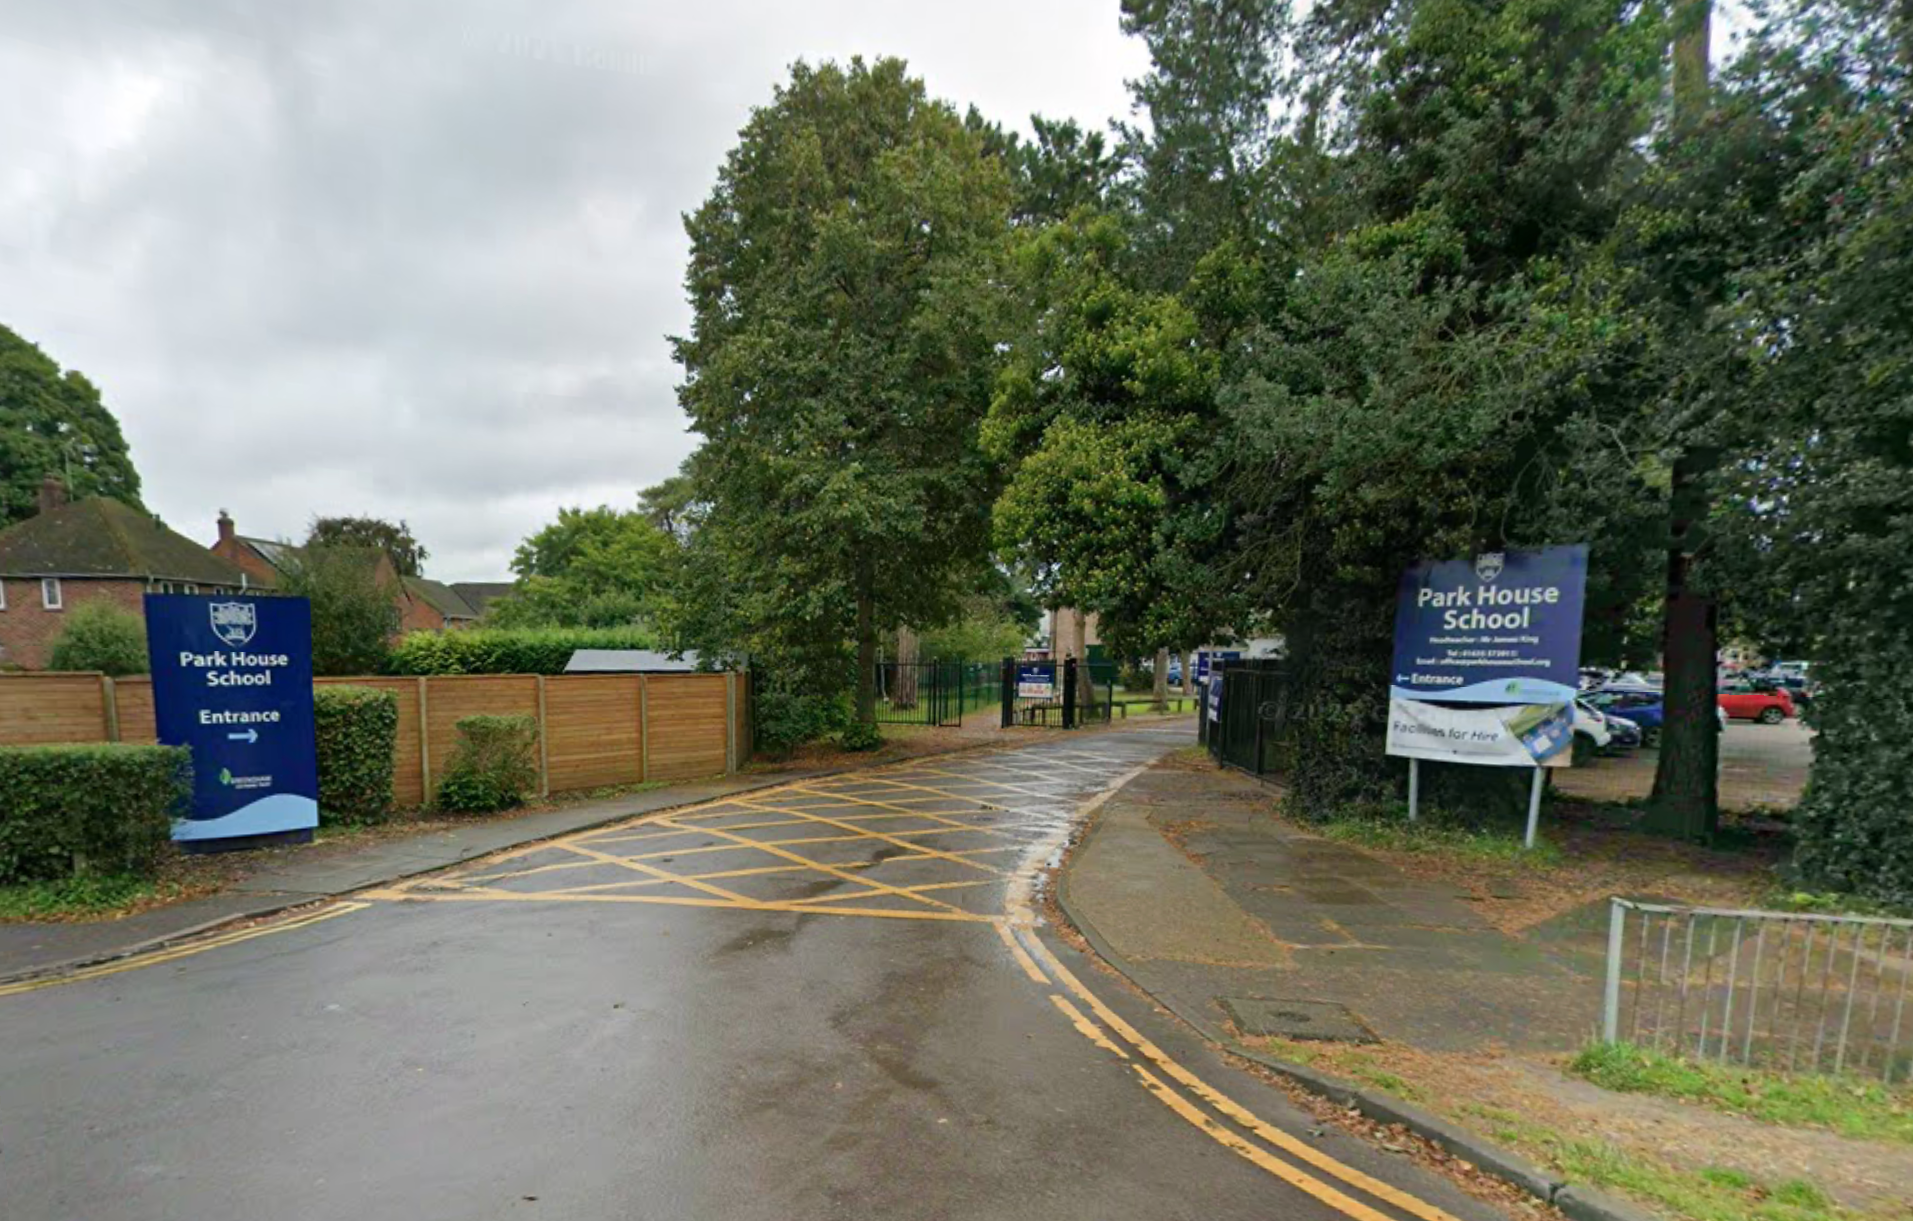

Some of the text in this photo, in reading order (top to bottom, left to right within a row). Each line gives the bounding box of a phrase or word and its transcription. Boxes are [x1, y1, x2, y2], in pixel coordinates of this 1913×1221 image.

[1418, 585, 1560, 607] Park House
[1443, 607, 1529, 630] School
[180, 651, 288, 667] Park House
[206, 669, 271, 687] School
[1411, 673, 1464, 685] Entrance
[198, 709, 280, 724] Entrance
[1448, 726, 1468, 739] for
[1471, 729, 1500, 742] Hire
